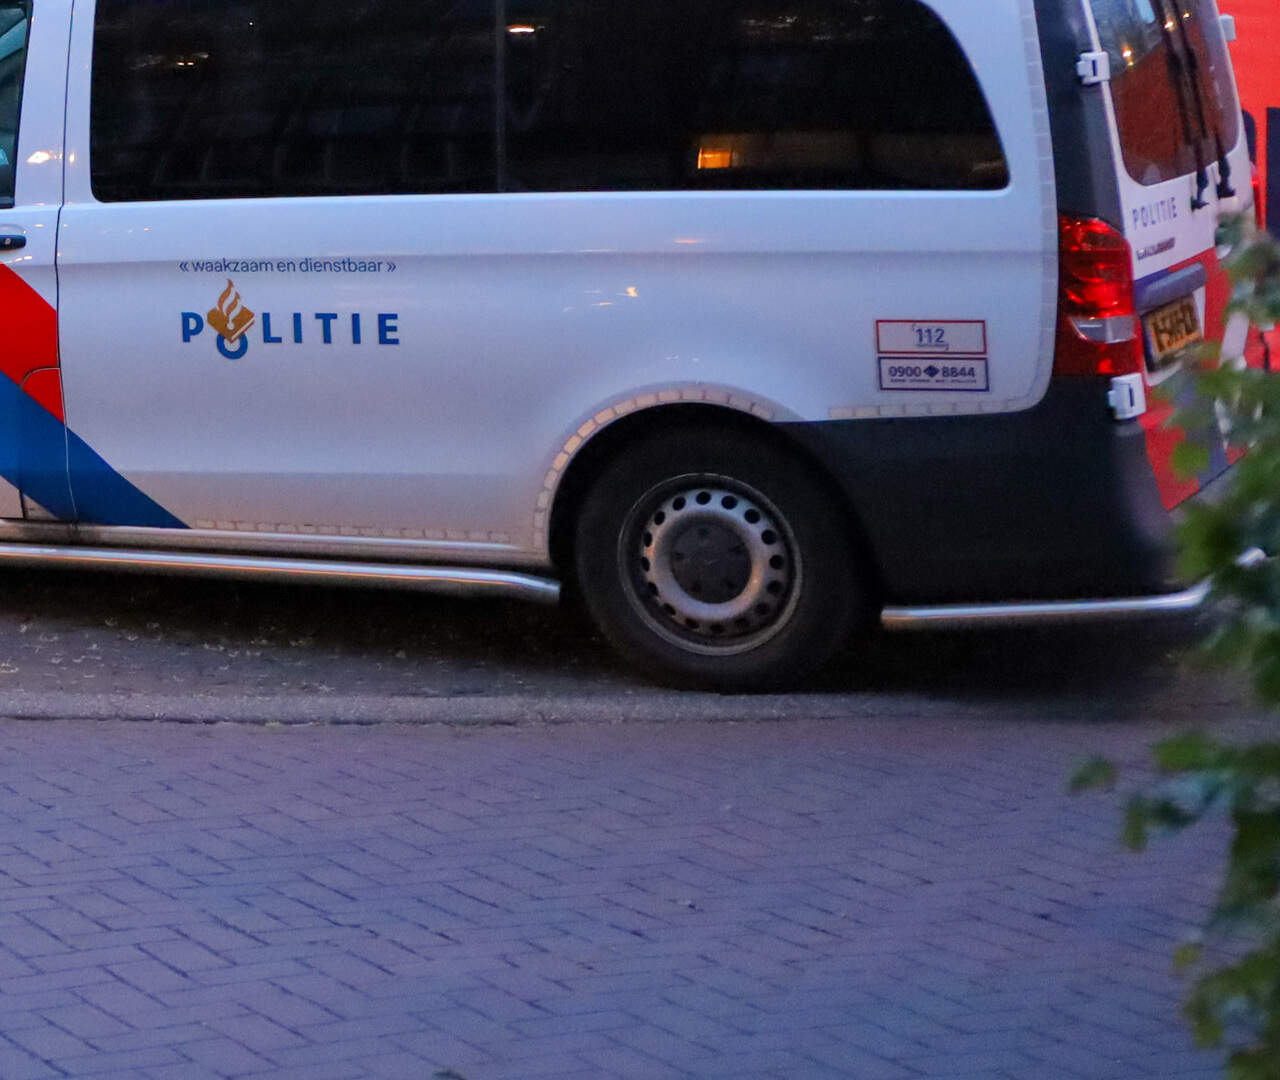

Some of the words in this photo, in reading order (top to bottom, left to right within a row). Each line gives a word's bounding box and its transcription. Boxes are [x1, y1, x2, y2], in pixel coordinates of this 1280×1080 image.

[1132, 197, 1177, 230] POLITIE
[192, 258, 274, 272] waakzaam
[276, 262, 296, 272] en
[299, 258, 382, 273] dienstbaar
[181, 311, 400, 360] POLITIE
[916, 328, 945, 343] 112
[888, 366, 921, 378] 0900
[942, 367, 976, 378] 8844
